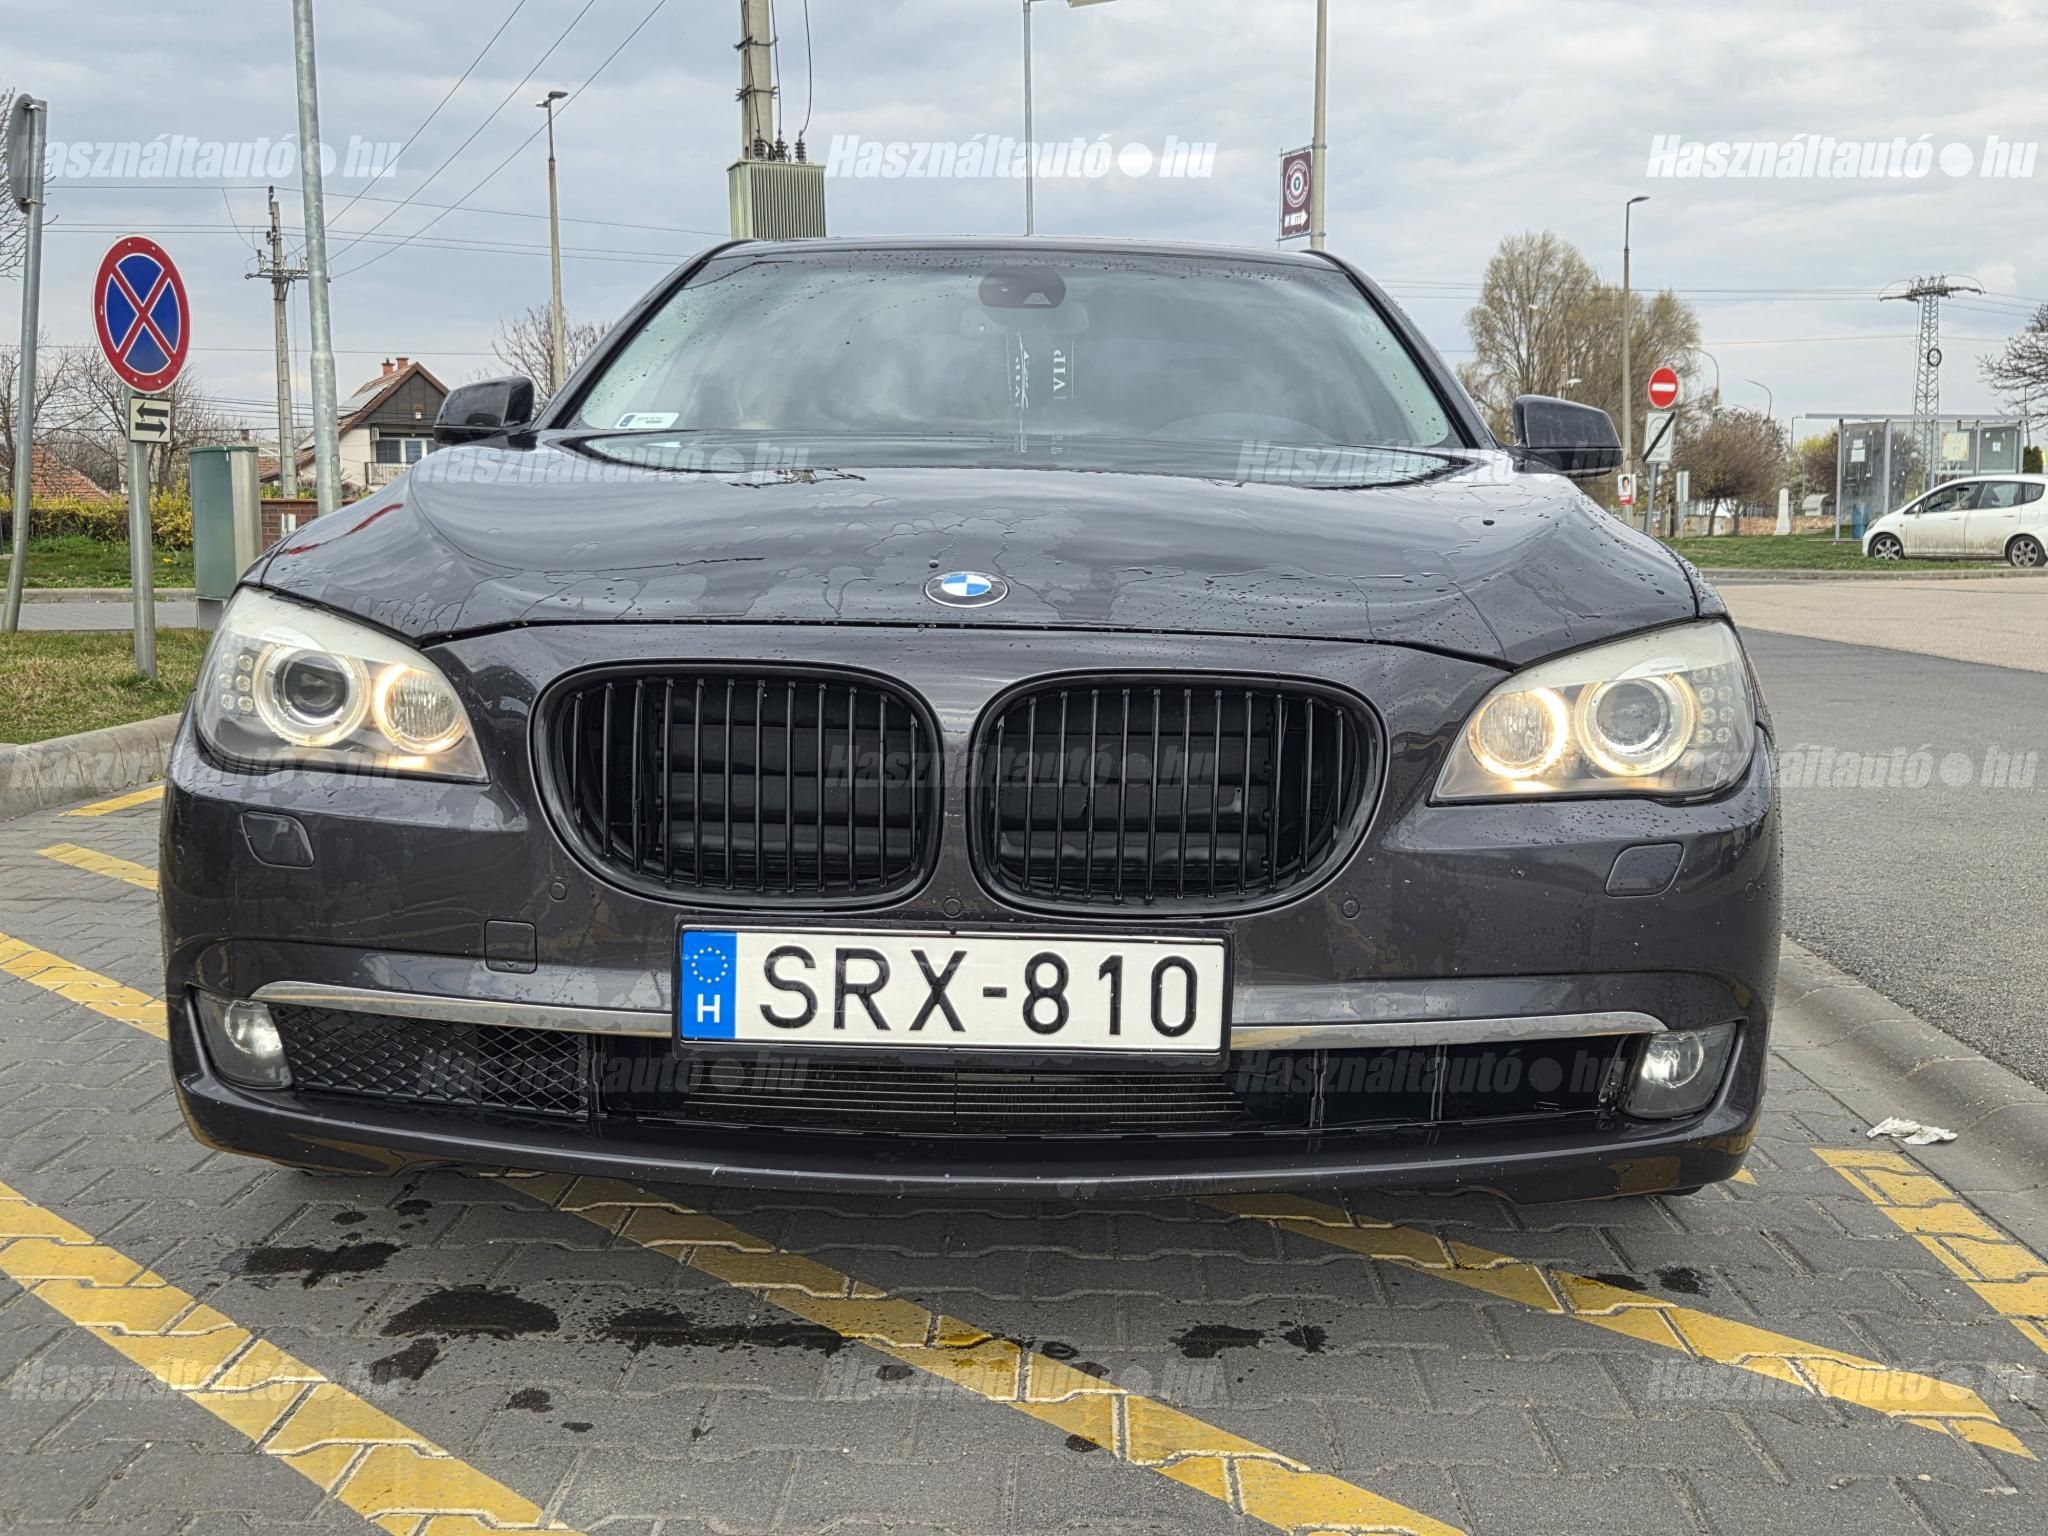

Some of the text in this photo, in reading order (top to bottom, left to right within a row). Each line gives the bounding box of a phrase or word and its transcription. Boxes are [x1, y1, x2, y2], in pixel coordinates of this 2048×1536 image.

[1053, 349, 1067, 393] VIP
[696, 994, 721, 1023] H
[759, 945, 1197, 1038] SRX-810
